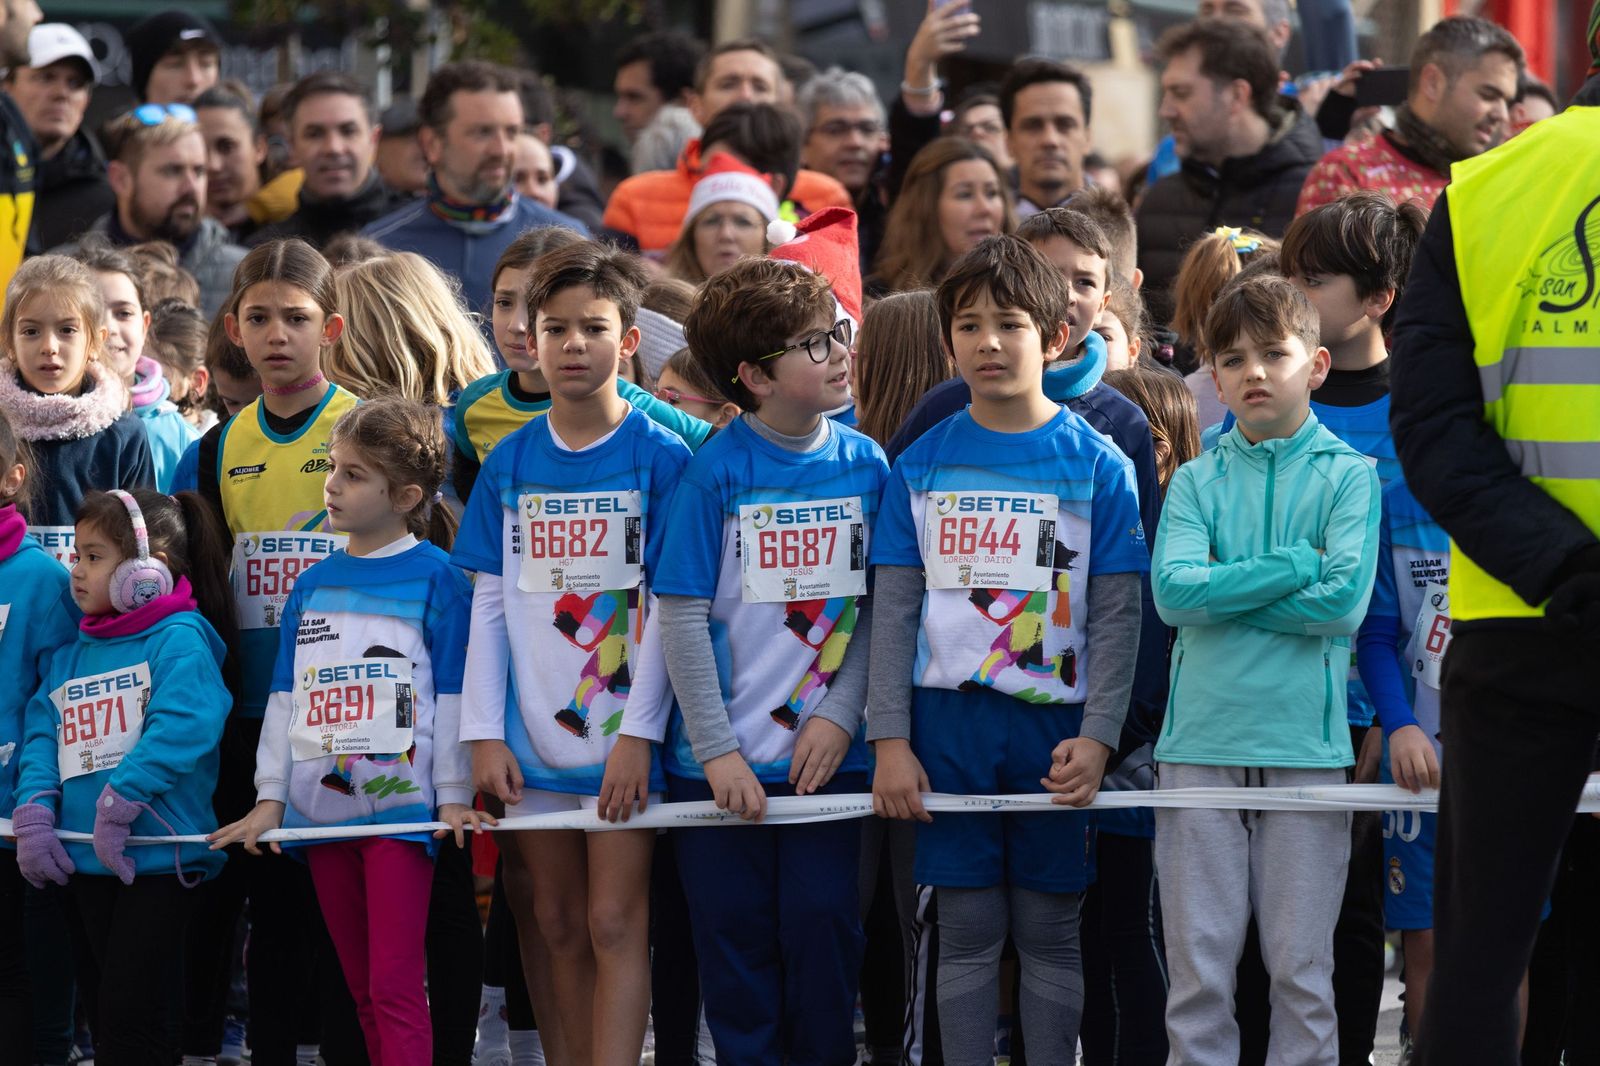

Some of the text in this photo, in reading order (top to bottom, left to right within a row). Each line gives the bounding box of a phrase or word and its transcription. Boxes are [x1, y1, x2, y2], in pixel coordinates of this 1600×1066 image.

[544, 498, 628, 514] SETEL
[776, 505, 852, 524] SETEL
[958, 496, 1043, 514] SETEL
[531, 519, 608, 558] 6682
[939, 517, 1021, 556] 6644
[759, 527, 837, 569] 6687
[943, 555, 1013, 564] LORENZO DAITO
[799, 582, 830, 590] Ayuntamiento
[311, 618, 326, 626] SAN
[318, 664, 398, 683] SETEL
[67, 672, 143, 701] SETEL
[307, 685, 375, 727] 6691
[63, 695, 127, 746] 6971
[320, 722, 358, 733] VICTORIA
[84, 738, 105, 749] ALBA
